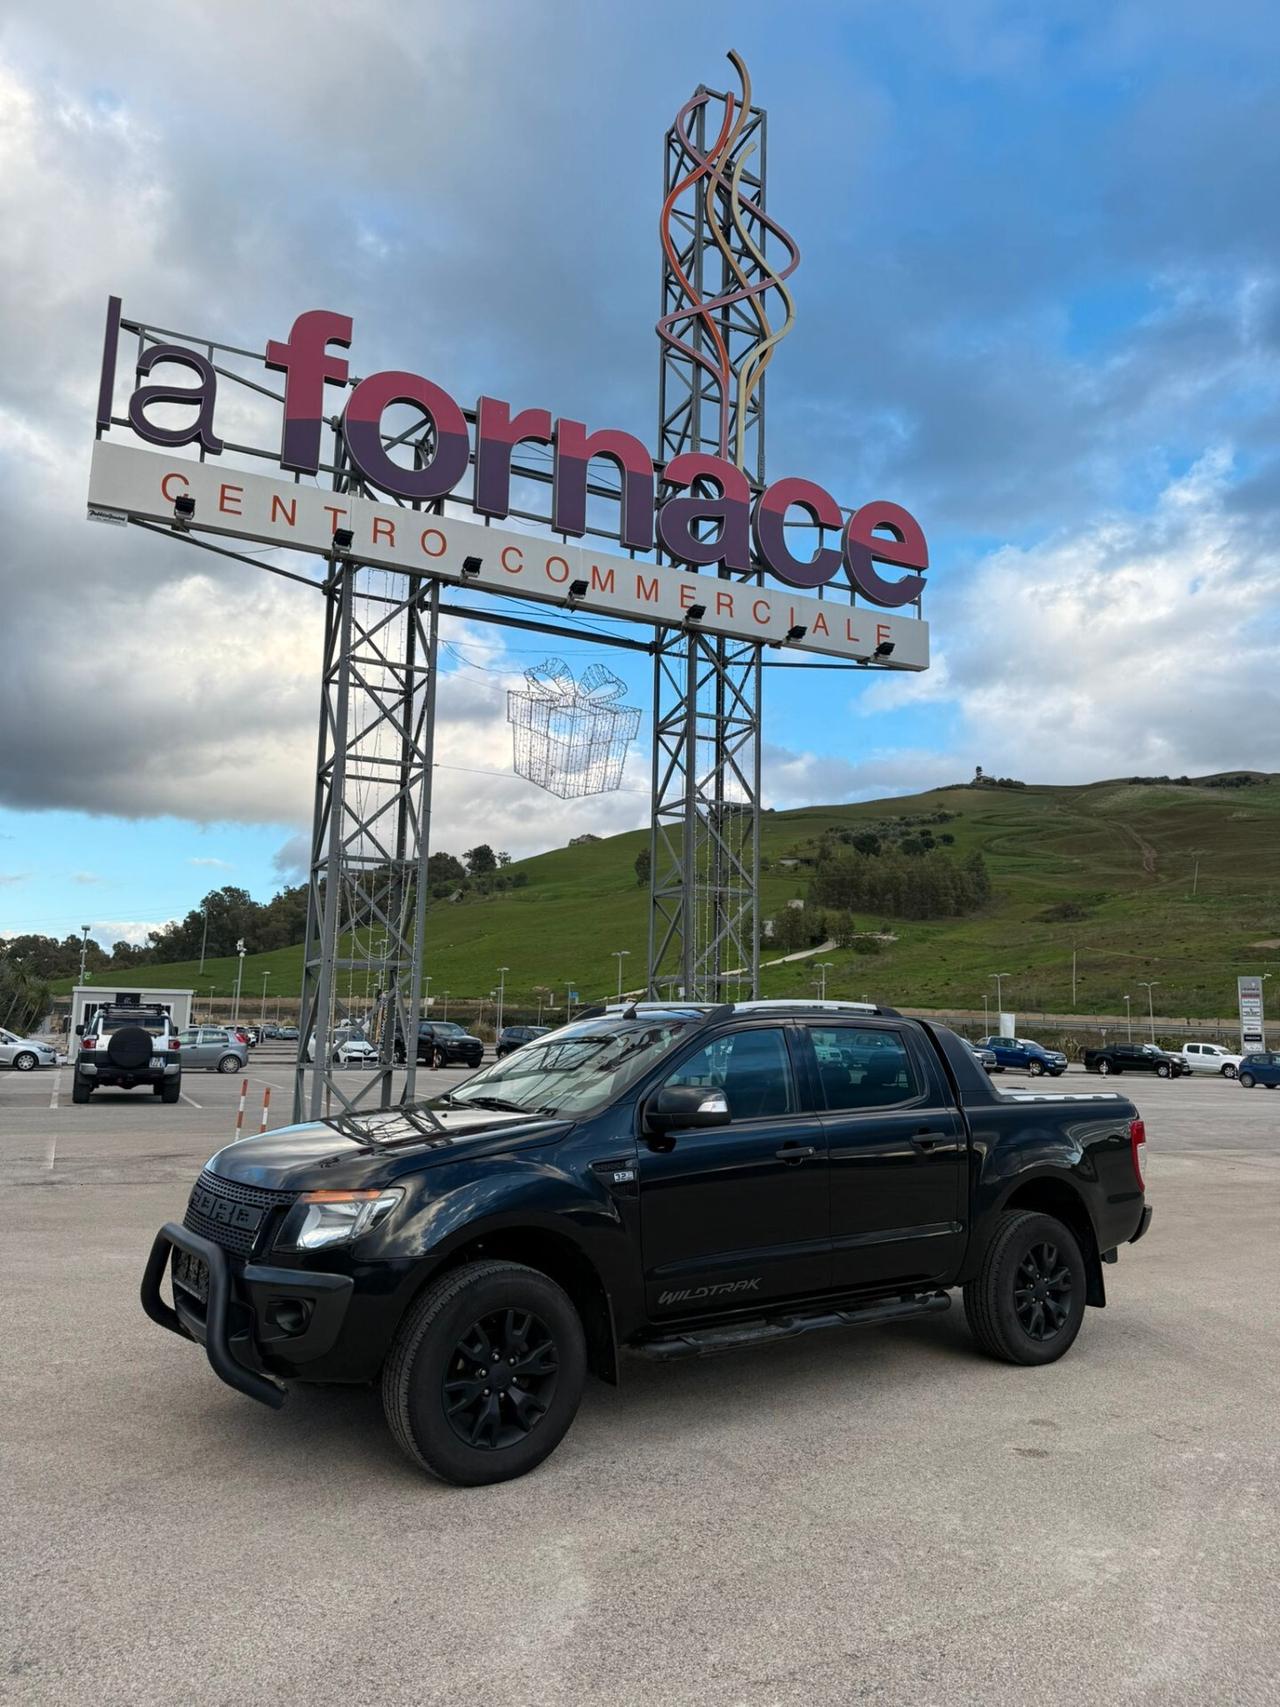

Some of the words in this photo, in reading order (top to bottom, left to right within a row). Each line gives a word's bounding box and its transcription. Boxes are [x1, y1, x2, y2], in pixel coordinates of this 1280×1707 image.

[96, 295, 224, 455] la
[265, 309, 929, 608] fornace
[161, 473, 448, 558] CENTRO
[501, 546, 891, 646] COMMERCIALE
[658, 1278, 762, 1305] WILDTRAK
